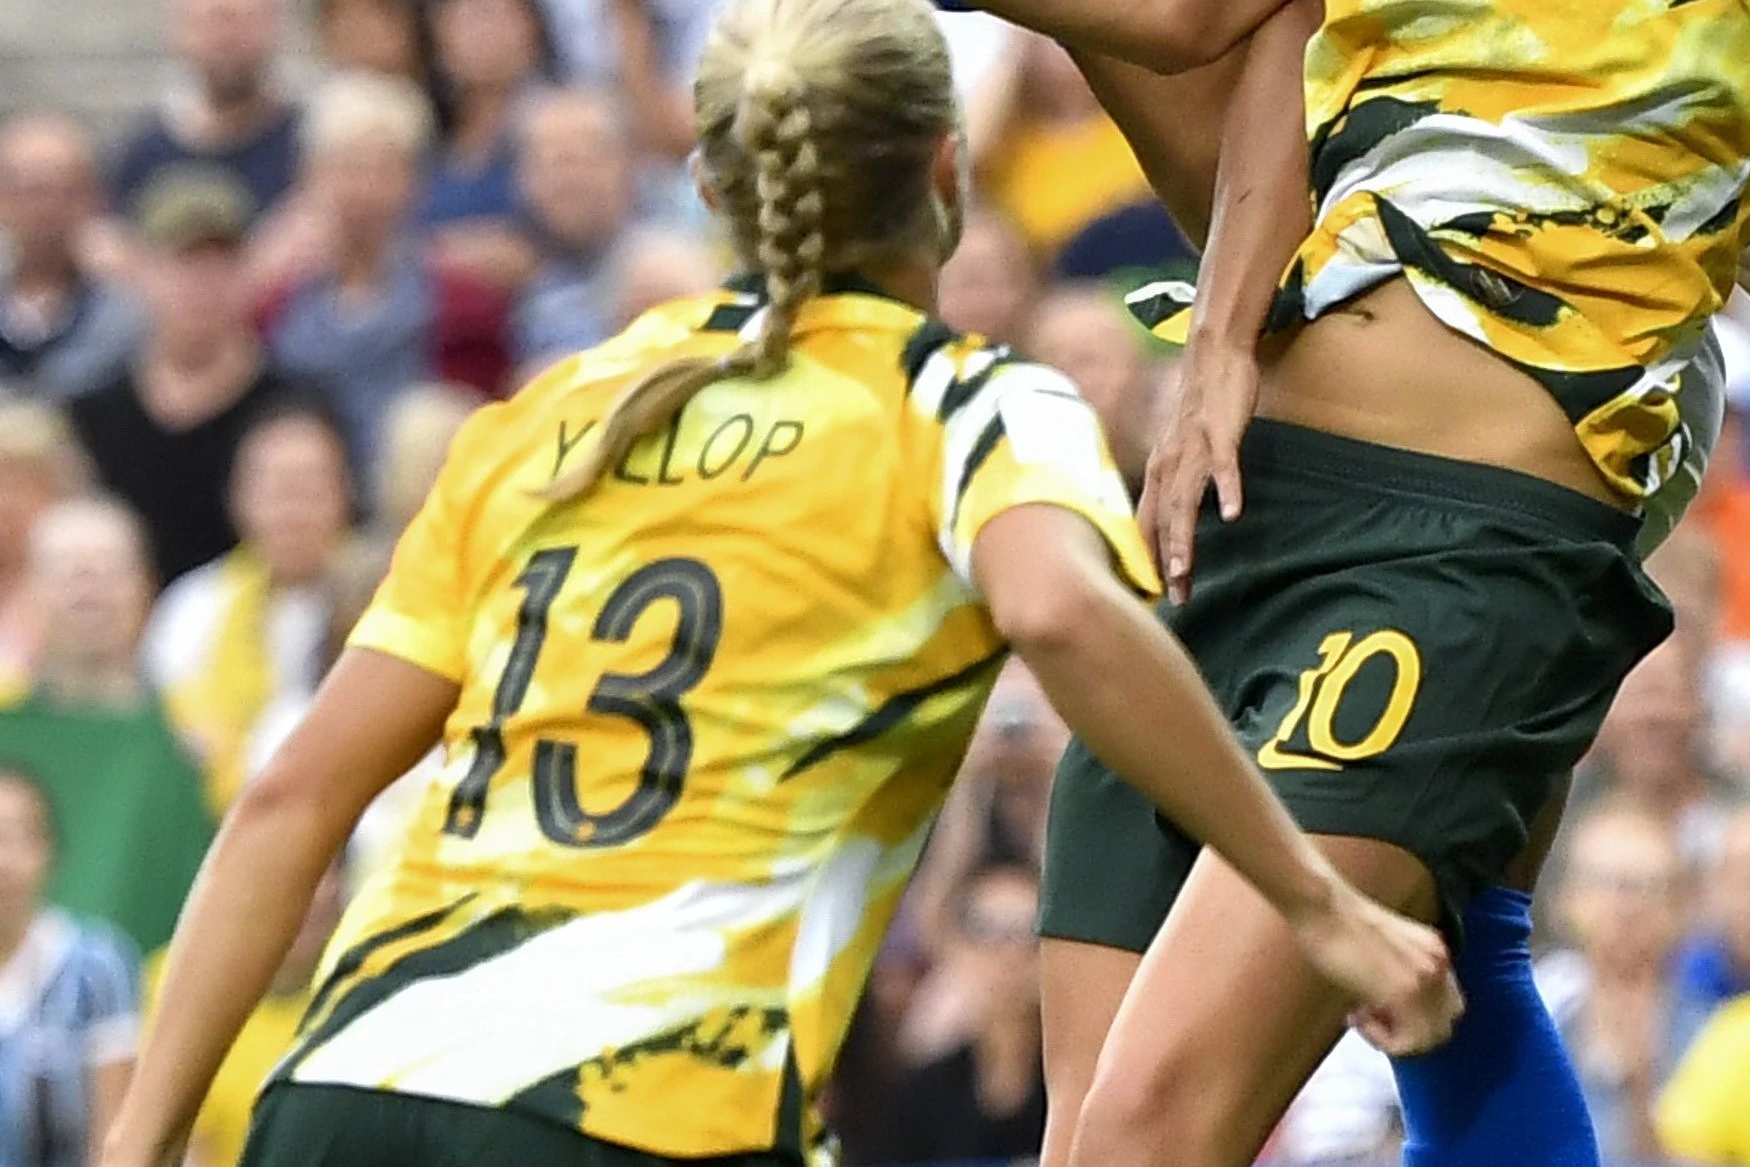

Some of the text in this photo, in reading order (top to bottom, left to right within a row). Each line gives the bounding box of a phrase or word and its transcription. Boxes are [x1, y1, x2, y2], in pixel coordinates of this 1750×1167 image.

[553, 413, 805, 486] YLLOP
[442, 545, 724, 849] 13
[1276, 630, 1421, 760] 10
